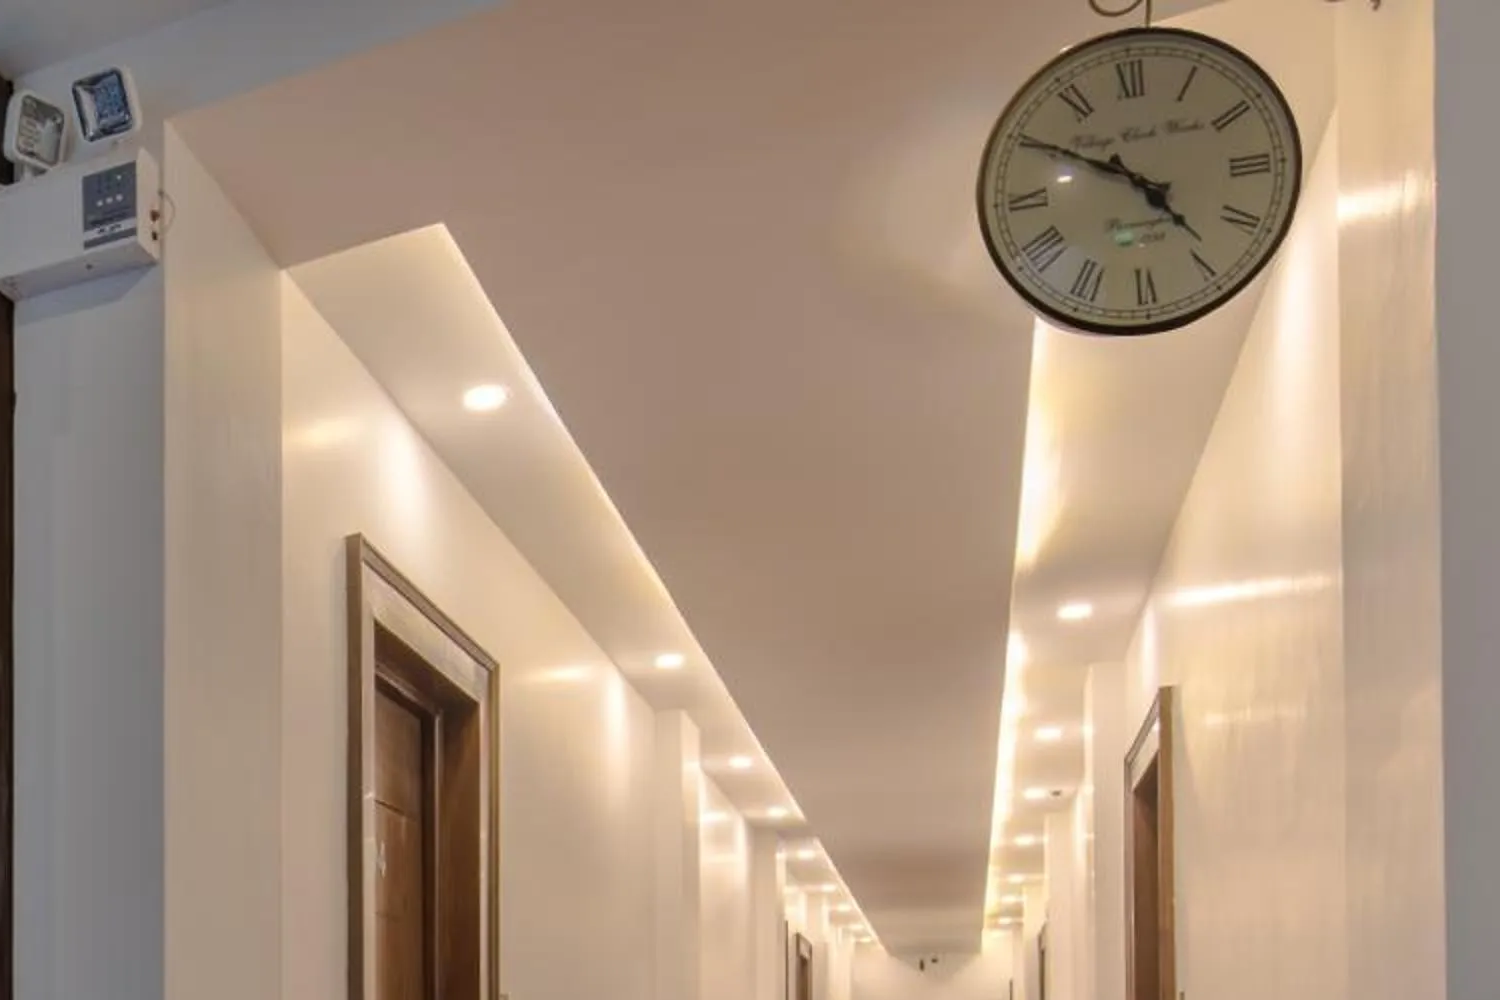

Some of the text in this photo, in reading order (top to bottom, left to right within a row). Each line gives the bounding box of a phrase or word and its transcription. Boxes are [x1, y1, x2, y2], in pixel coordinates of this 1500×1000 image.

[1116, 59, 1145, 100] XII
[1176, 65, 1198, 102] I
[1058, 83, 1095, 124] XI
[1211, 100, 1251, 132] II
[1228, 153, 1271, 177] III
